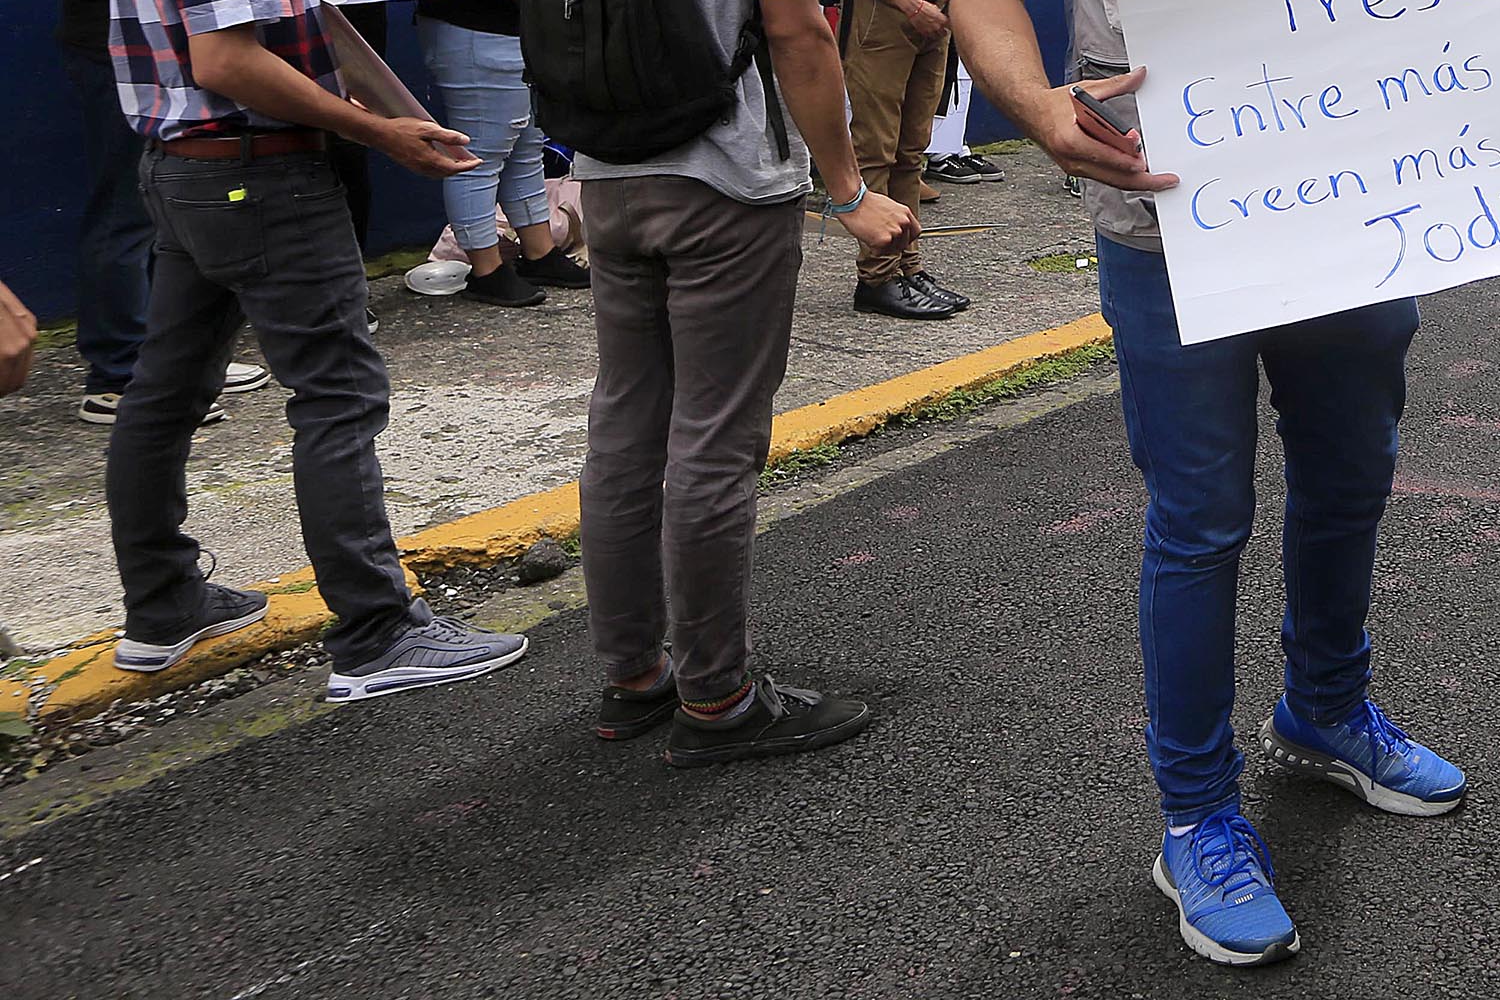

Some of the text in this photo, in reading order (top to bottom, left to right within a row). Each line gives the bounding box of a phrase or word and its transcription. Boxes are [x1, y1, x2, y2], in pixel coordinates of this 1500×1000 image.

[1181, 63, 1358, 149] Entre
[1376, 41, 1494, 103] más
[1189, 168, 1368, 232] Creen
